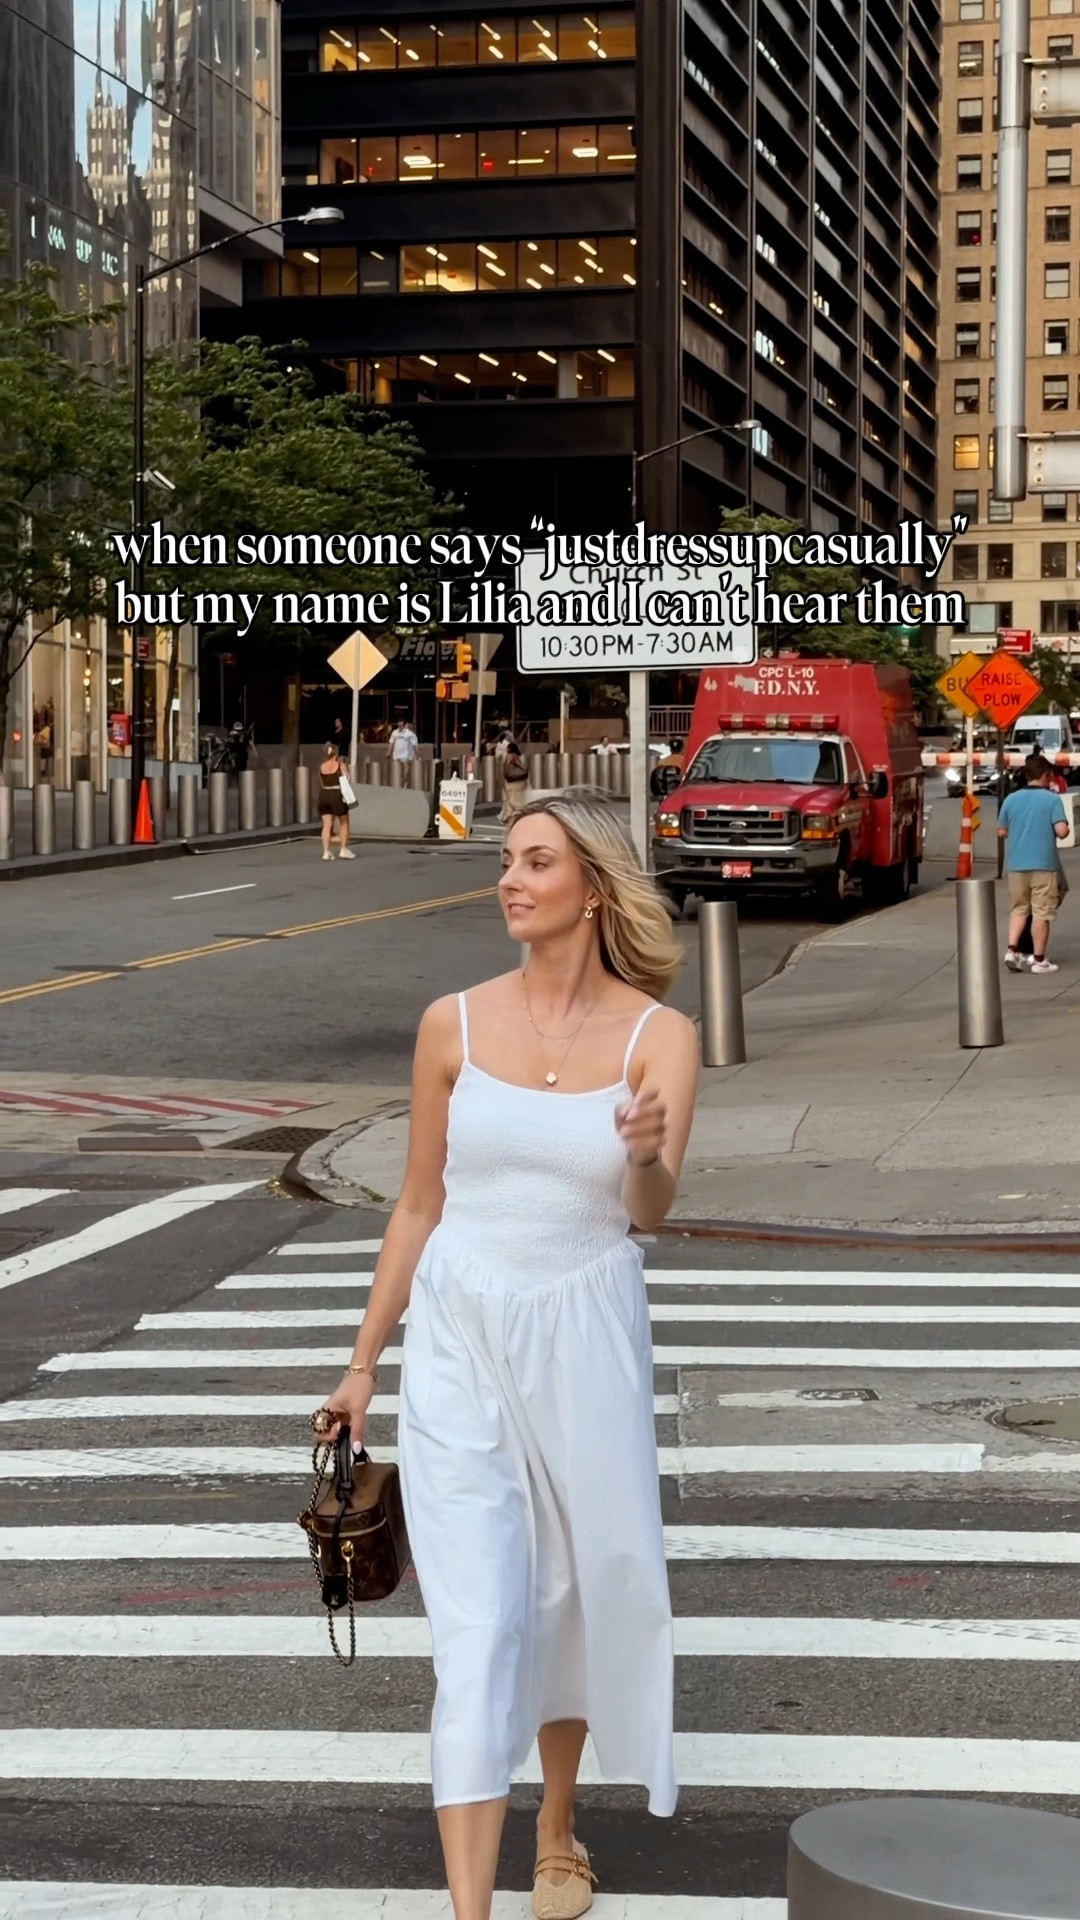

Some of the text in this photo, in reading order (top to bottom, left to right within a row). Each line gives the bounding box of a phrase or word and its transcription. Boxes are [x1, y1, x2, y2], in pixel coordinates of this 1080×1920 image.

[759, 667, 814, 678] CPC L-10
[981, 673, 1022, 686] RAISE
[754, 680, 820, 695] F.D.N.Y.
[983, 694, 1021, 706] PLOW
